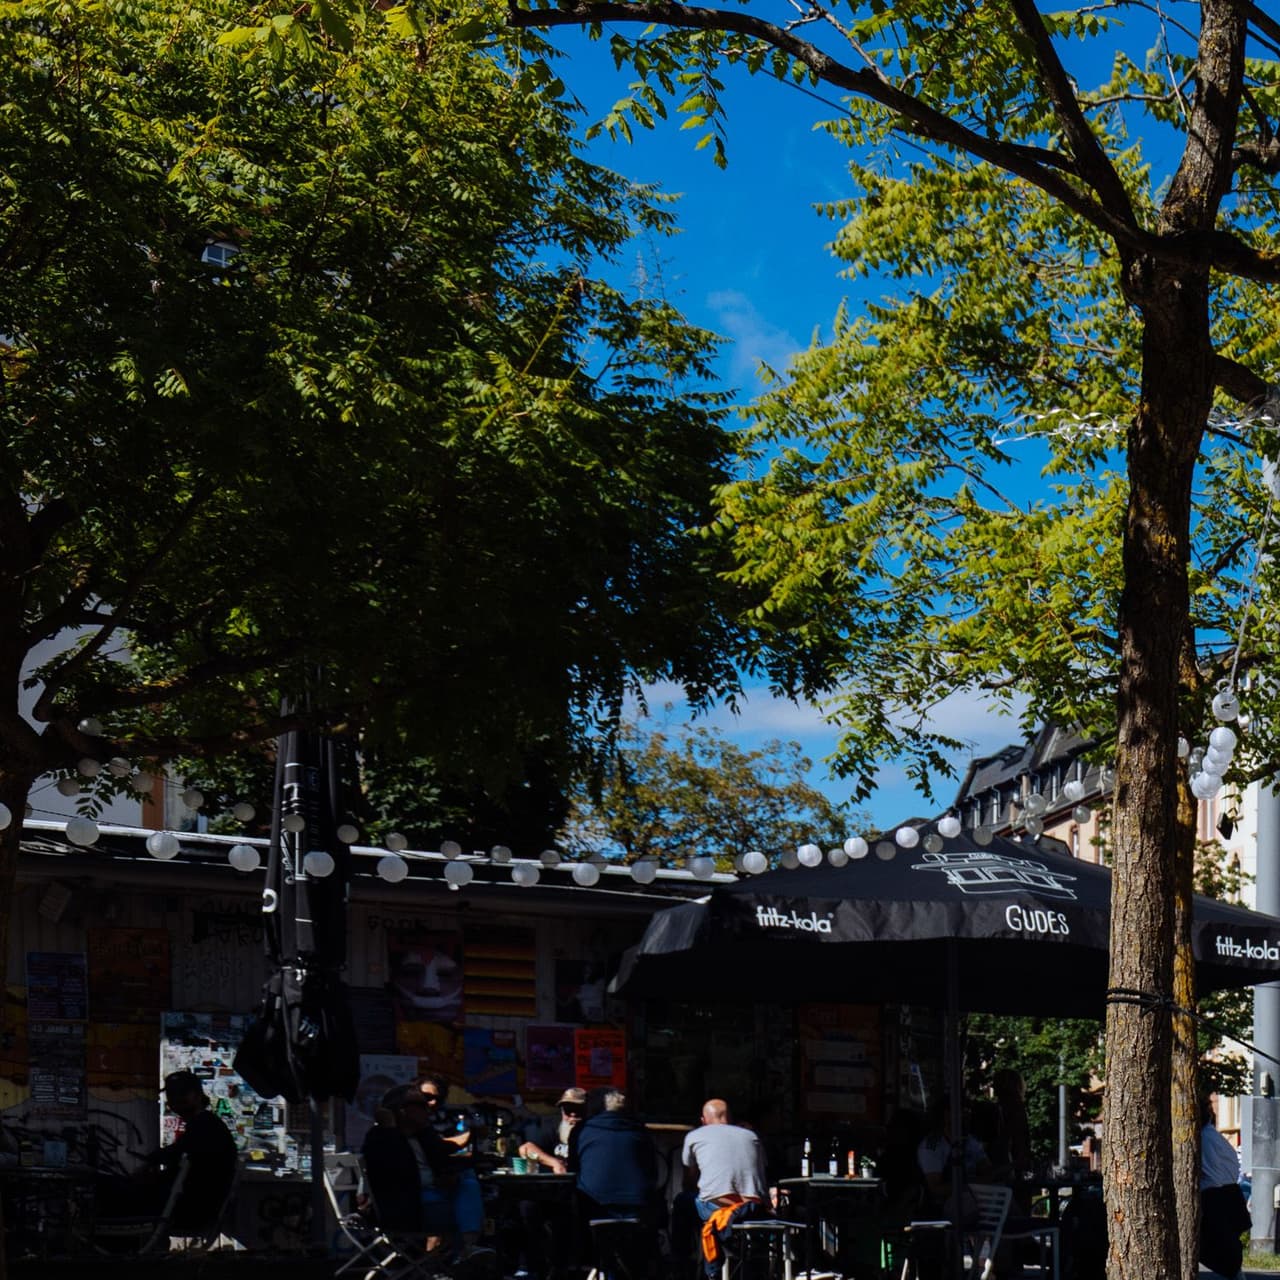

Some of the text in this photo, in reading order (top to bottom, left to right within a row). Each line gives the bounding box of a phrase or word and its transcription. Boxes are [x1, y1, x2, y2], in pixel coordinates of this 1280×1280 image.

[756, 906, 832, 933] fritz-kola
[1005, 905, 1069, 935] GUDES
[1216, 936, 1279, 960] fritz-kola
